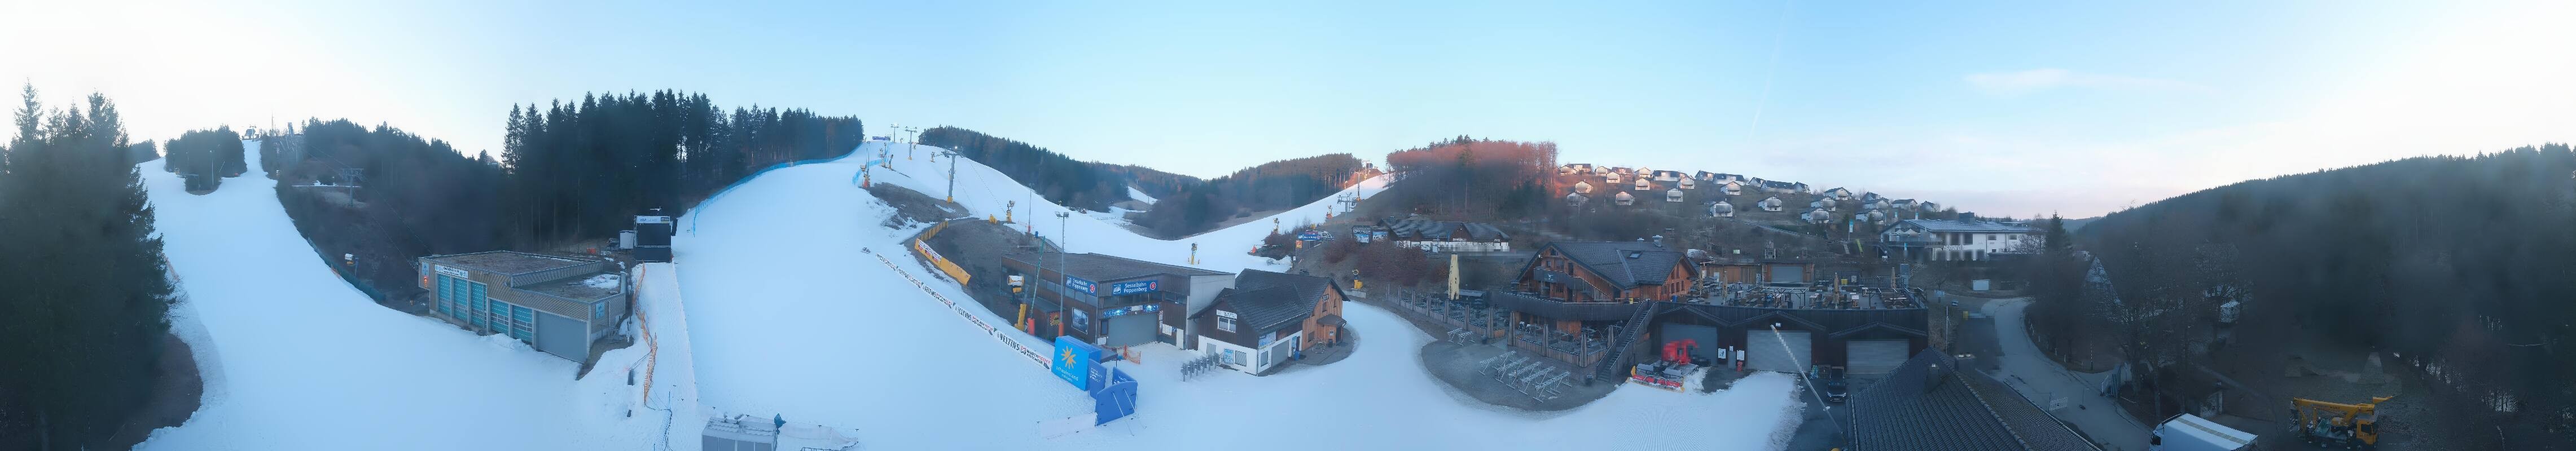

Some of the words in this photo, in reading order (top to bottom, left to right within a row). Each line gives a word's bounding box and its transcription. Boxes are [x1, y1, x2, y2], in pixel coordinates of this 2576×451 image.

[1000, 333, 1020, 351] VELTINS
[1056, 366, 1078, 381] schauinsland
[1061, 374, 1073, 383] reisen
